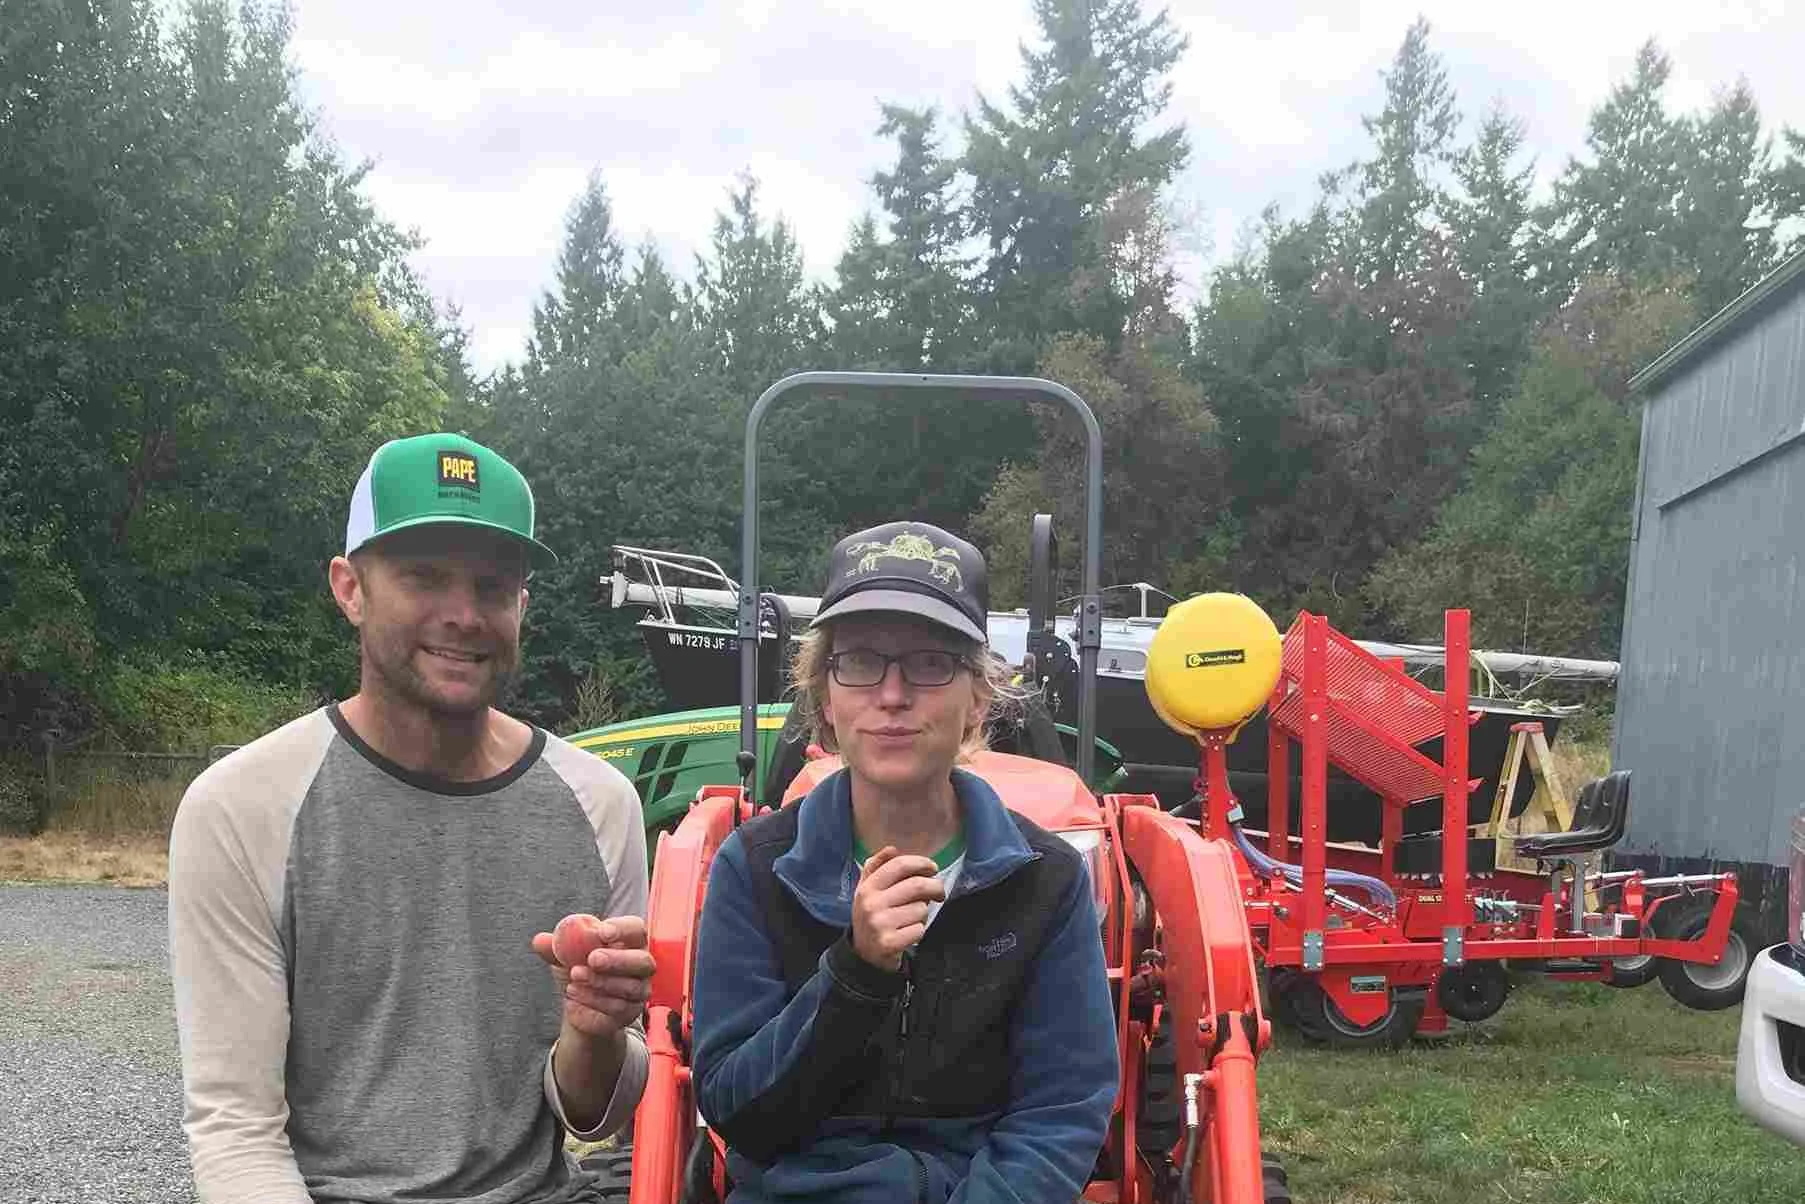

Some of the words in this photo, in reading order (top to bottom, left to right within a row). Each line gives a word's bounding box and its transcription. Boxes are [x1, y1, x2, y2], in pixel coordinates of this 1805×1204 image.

[668, 631, 683, 646] WN
[712, 636, 726, 650] JF
[716, 721, 738, 732] DEE
